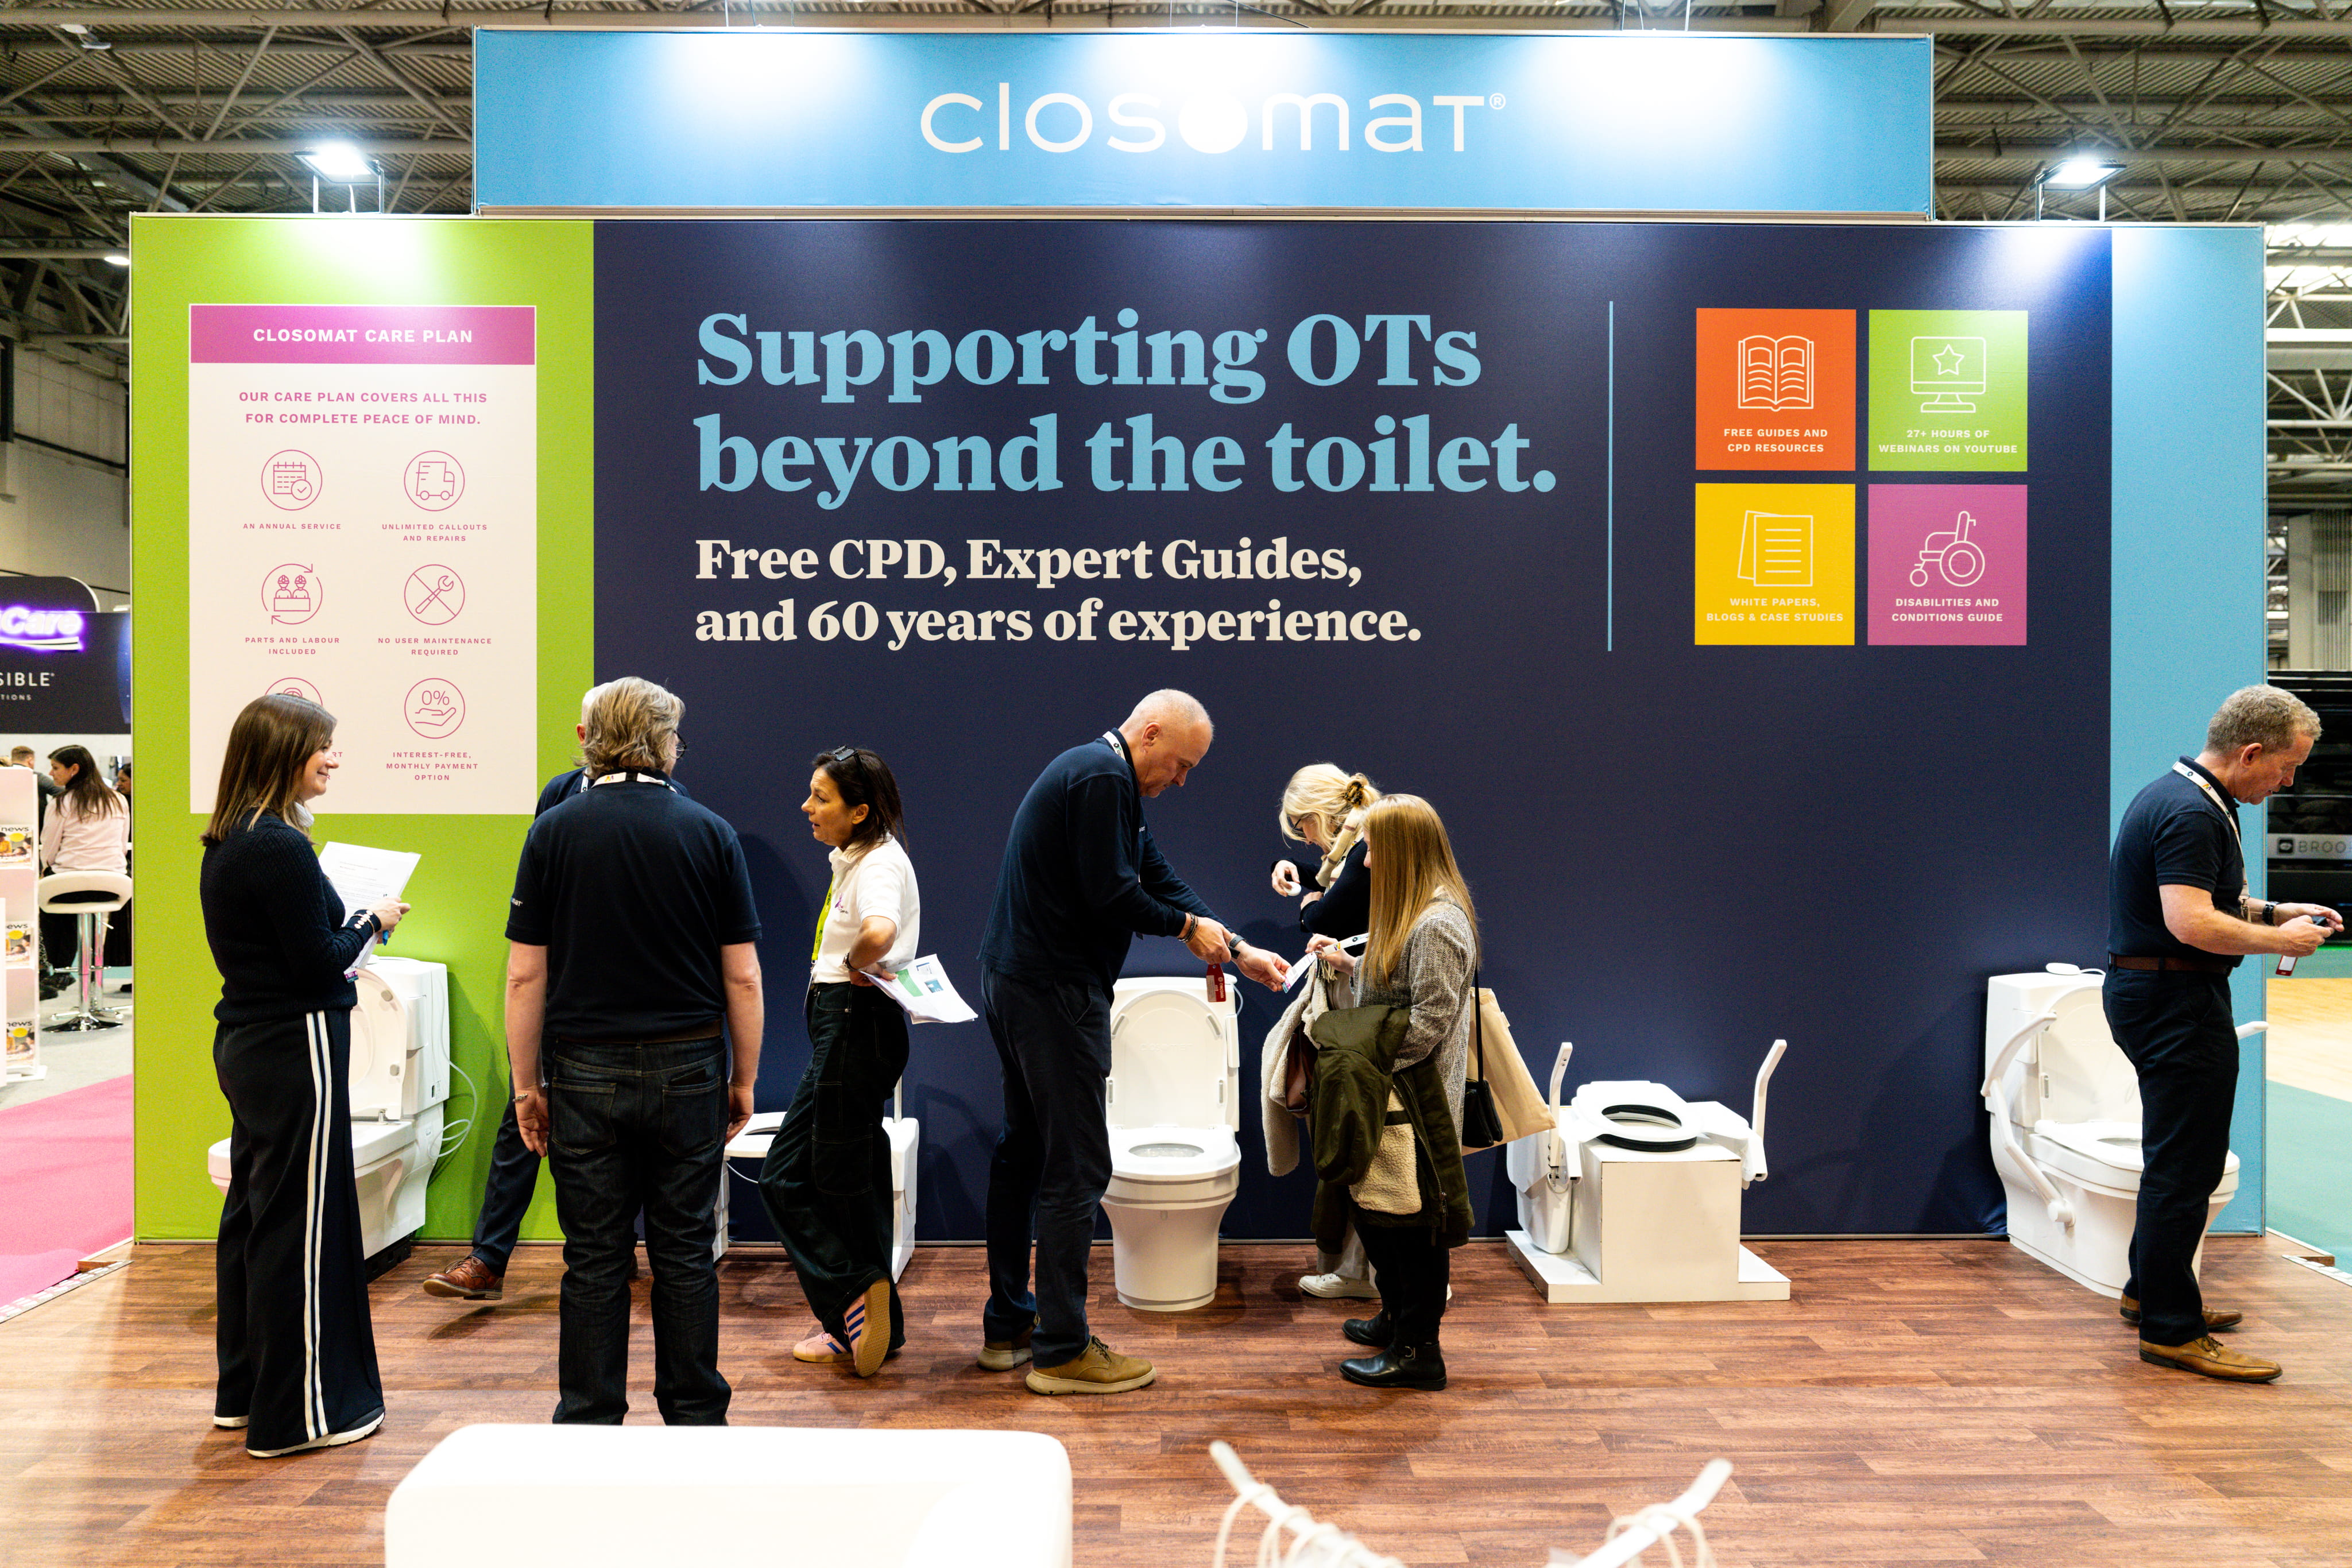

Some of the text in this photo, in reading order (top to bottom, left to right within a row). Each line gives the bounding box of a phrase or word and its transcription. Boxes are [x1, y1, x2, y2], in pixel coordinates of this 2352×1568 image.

[253, 328, 473, 344] CLOSOMAT CARE PLAN
[698, 308, 1481, 404] Supporting OTs
[239, 392, 487, 402] OUR CARE PLAN COVERS ALL THIS
[246, 413, 480, 424] FOR COMPLETE PEACE OF MIND.
[1724, 428, 1828, 437] FREE GUIDES AND
[1906, 429, 1990, 438] 27+ HOURS OF
[1727, 443, 1824, 452] CPD RESOURCES
[1878, 444, 2017, 453] WEBINARS ON YOUTUBE
[693, 413, 1556, 510] beyond the toilet.
[695, 536, 1361, 589] Free CPD, Expert Guides,
[1730, 598, 1820, 607] WHITE PAPERS,
[1895, 598, 1999, 607] DISABILITIES AND
[1707, 613, 1843, 622] BLOGS & CASE STUDIES
[1891, 613, 2003, 622] CONDITIONS GUIDE
[695, 597, 1421, 651] and 60 years of experience.
